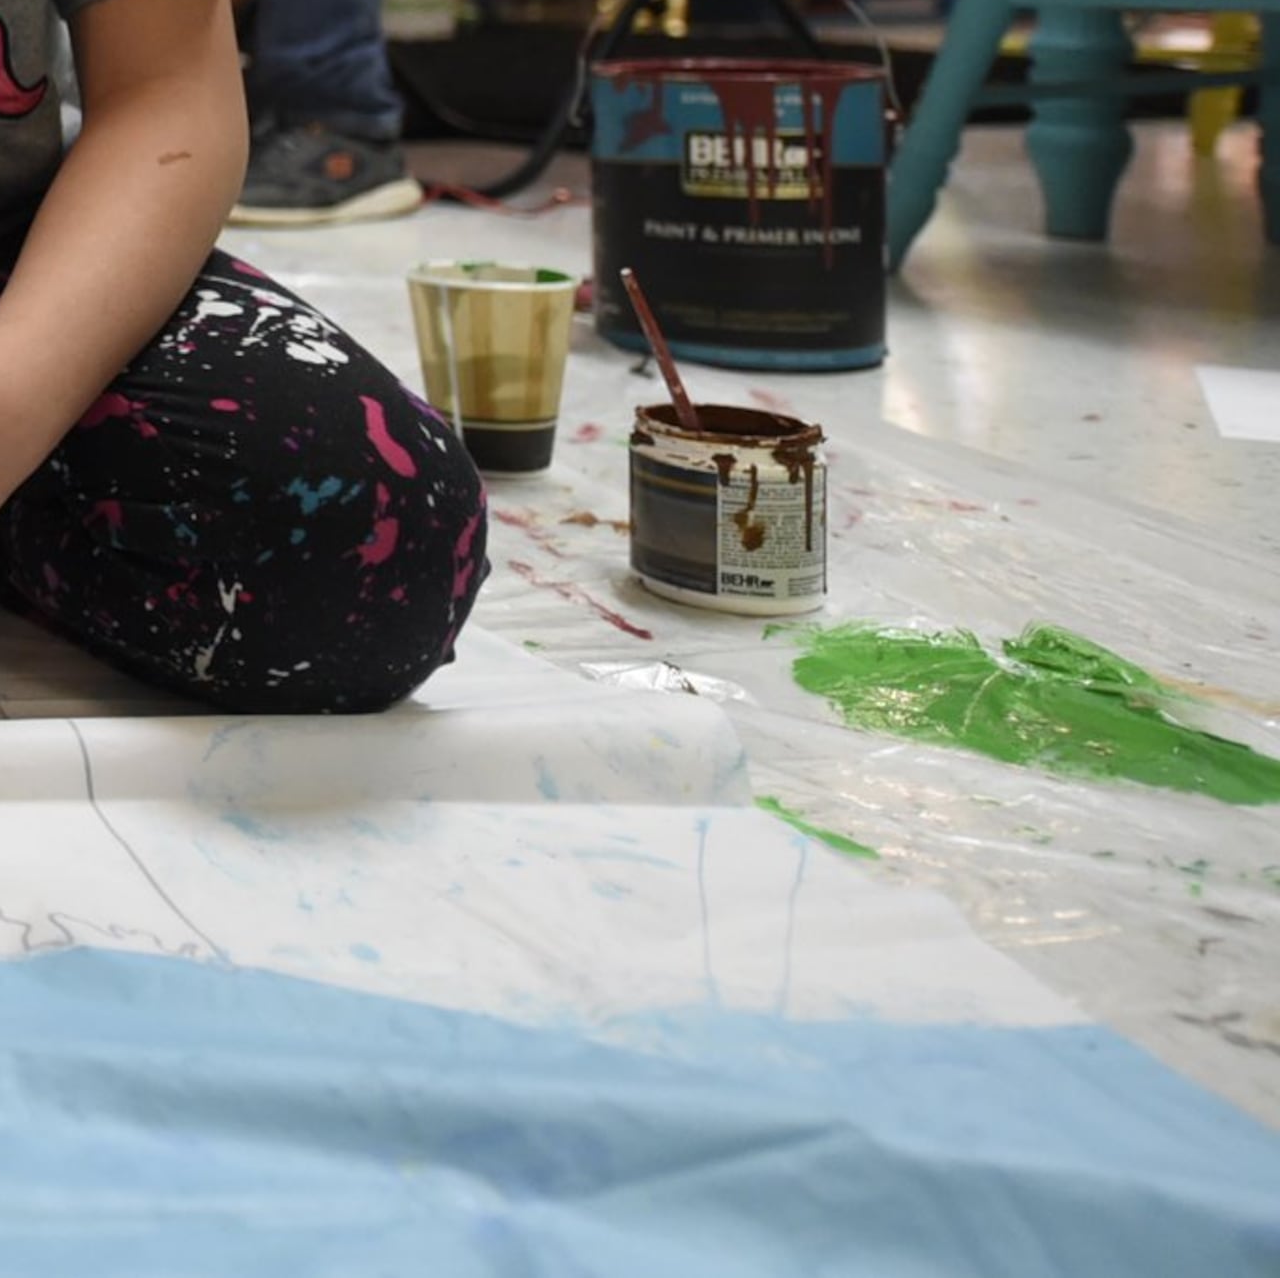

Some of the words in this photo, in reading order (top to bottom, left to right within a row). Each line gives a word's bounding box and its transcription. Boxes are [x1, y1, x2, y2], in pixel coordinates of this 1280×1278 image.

[644, 219, 697, 241] PAINT
[701, 224, 719, 243] &
[722, 225, 800, 246] PRIMER
[721, 573, 760, 588] BEHR
